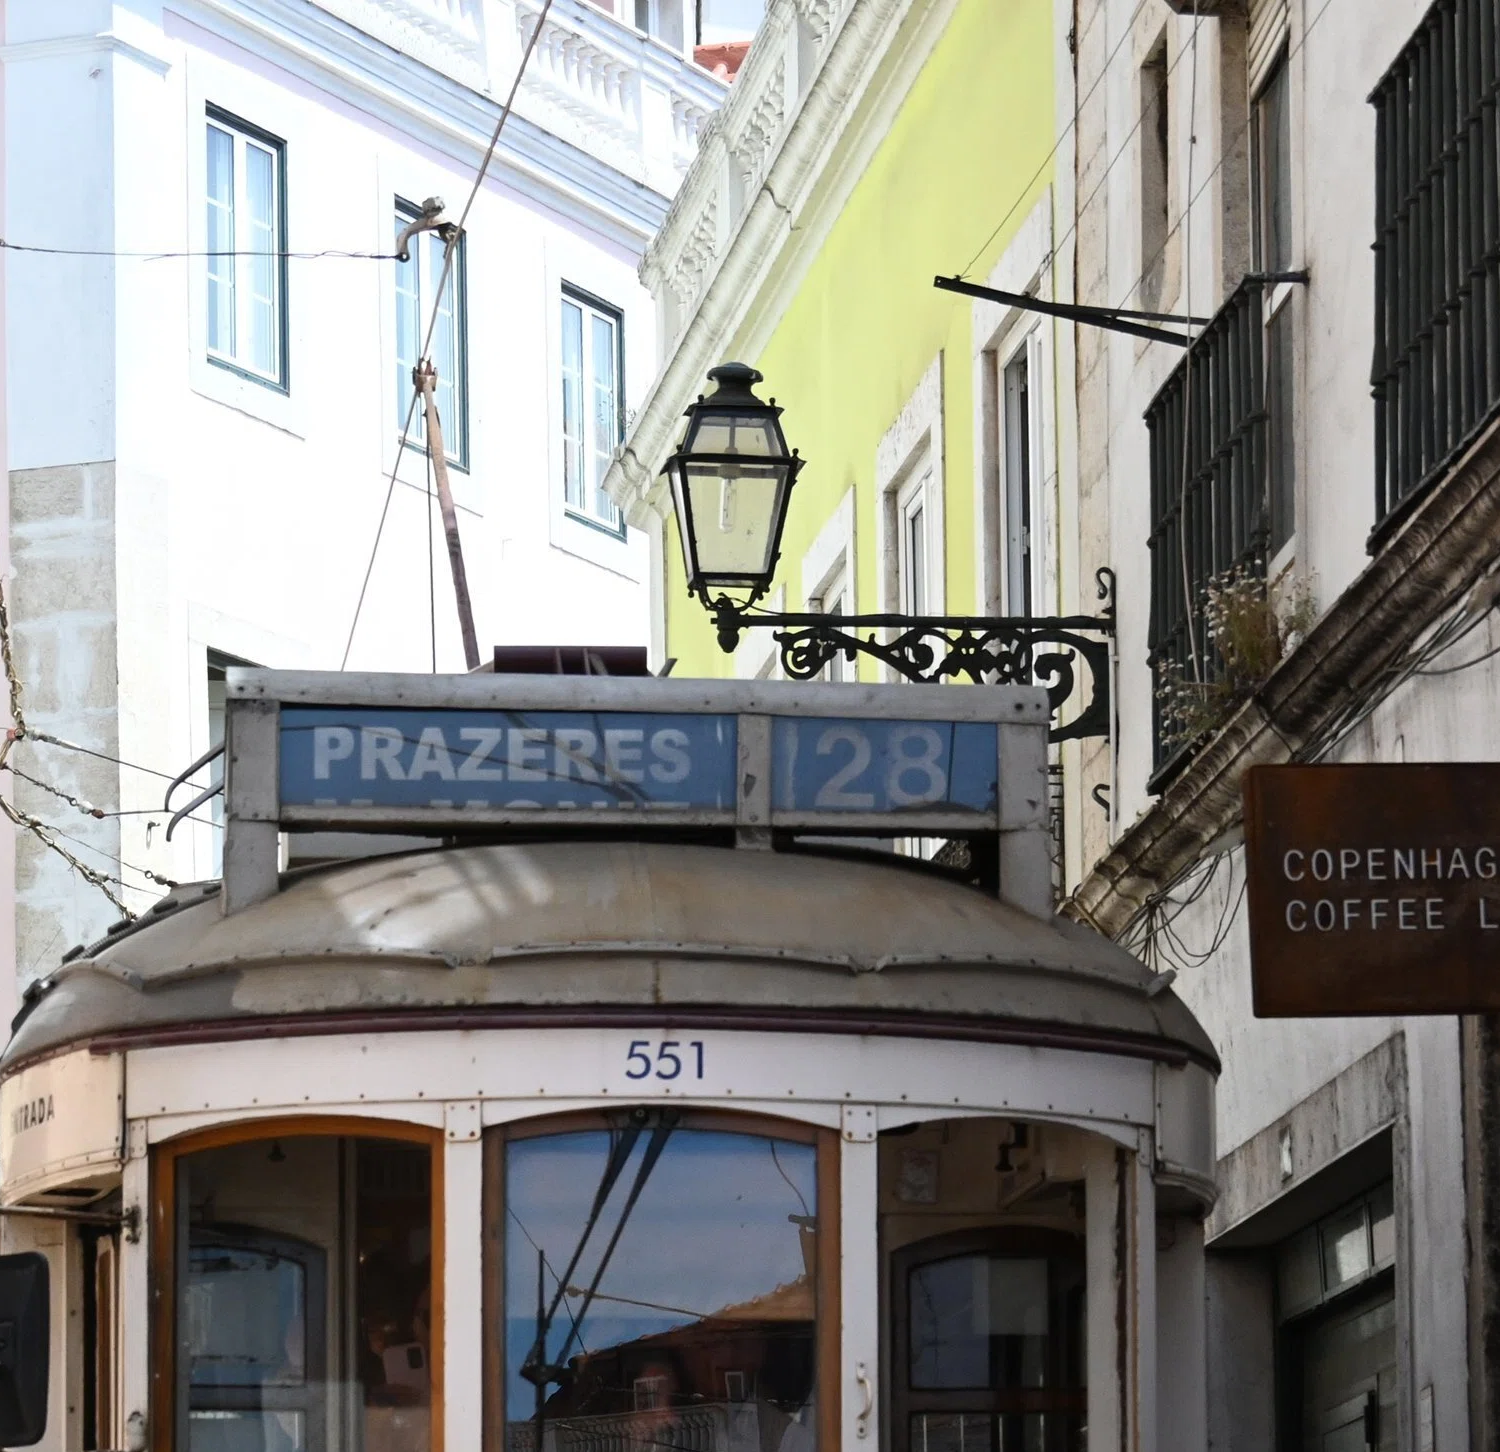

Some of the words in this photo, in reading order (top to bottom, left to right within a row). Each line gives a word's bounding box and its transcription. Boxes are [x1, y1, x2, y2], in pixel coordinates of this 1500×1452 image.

[313, 727, 691, 783] PRAZERES
[814, 725, 949, 808] 28
[1286, 898, 1445, 932] COFFEE
[625, 1041, 703, 1080] 551
